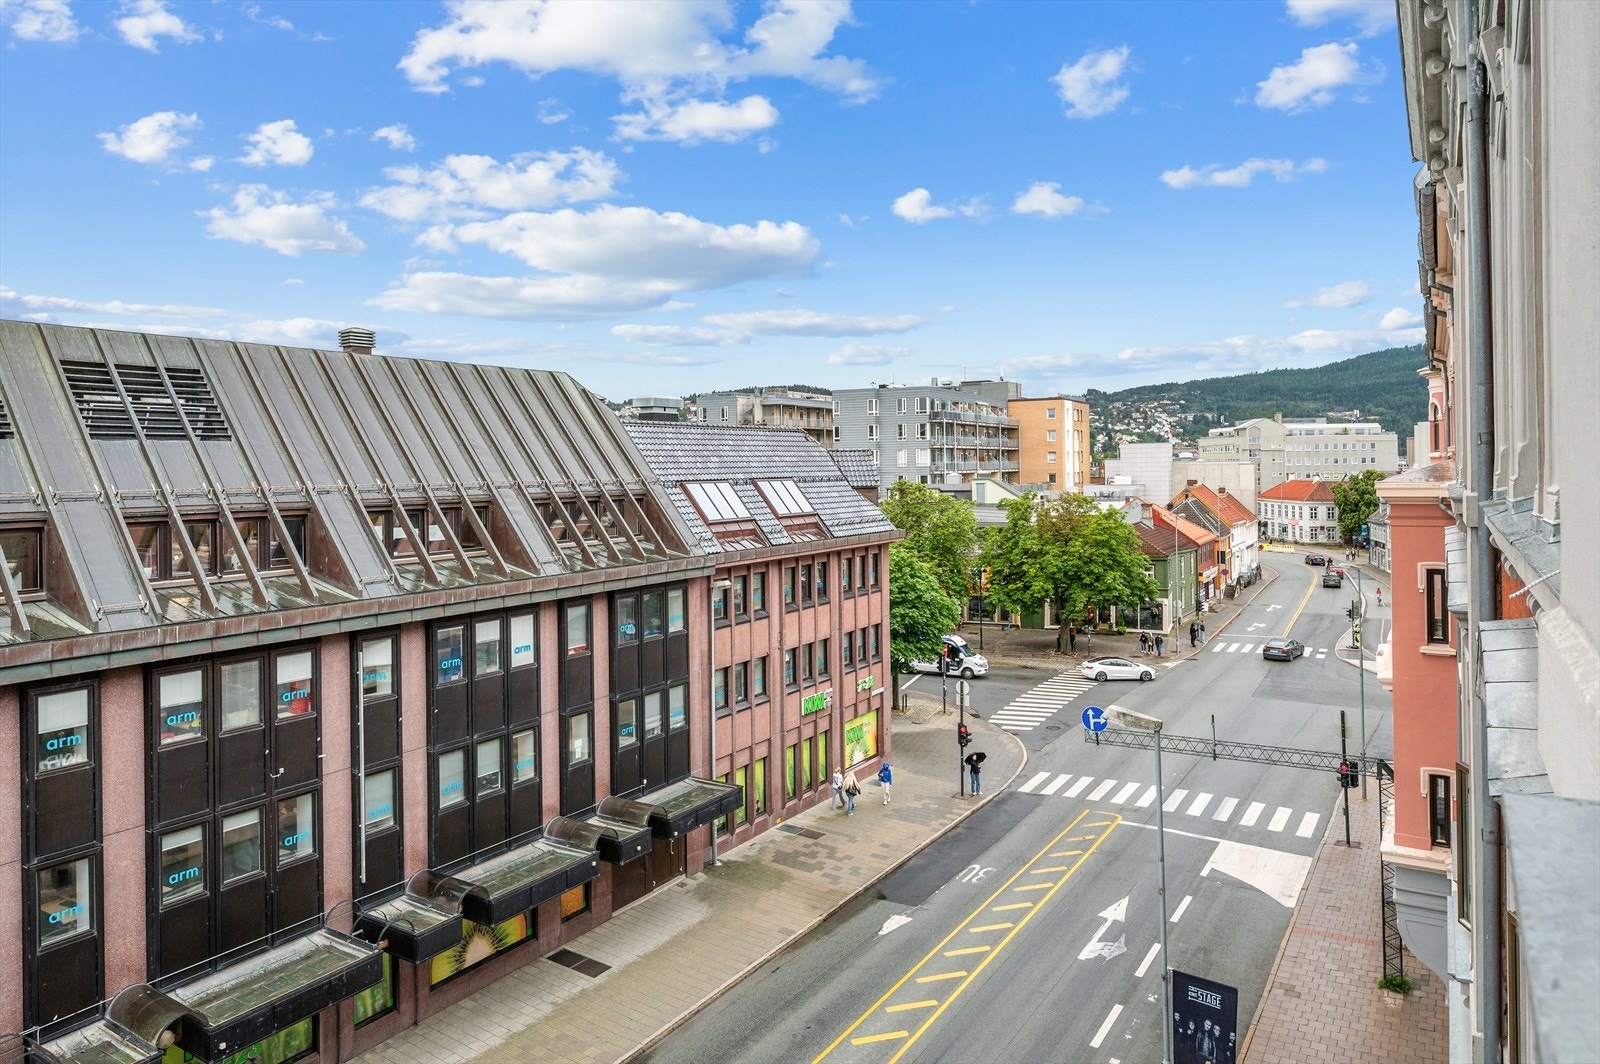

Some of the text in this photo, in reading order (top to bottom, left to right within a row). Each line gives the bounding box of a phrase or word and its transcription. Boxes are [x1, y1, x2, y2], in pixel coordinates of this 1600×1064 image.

[619, 623, 634, 633] arm
[514, 643, 531, 655] arm
[441, 657, 462, 670] arm
[363, 671, 387, 683] arm
[282, 687, 308, 703] arm
[802, 692, 825, 715] KIWI
[166, 709, 197, 726] arm
[621, 725, 635, 736] arm
[47, 733, 82, 751] arm
[516, 757, 533, 771] arm
[442, 780, 463, 794] arm
[369, 805, 392, 819] arm
[284, 831, 309, 847] arm
[168, 867, 199, 885] arm
[48, 903, 83, 924] arm
[1198, 991, 1221, 1007] STAGE
